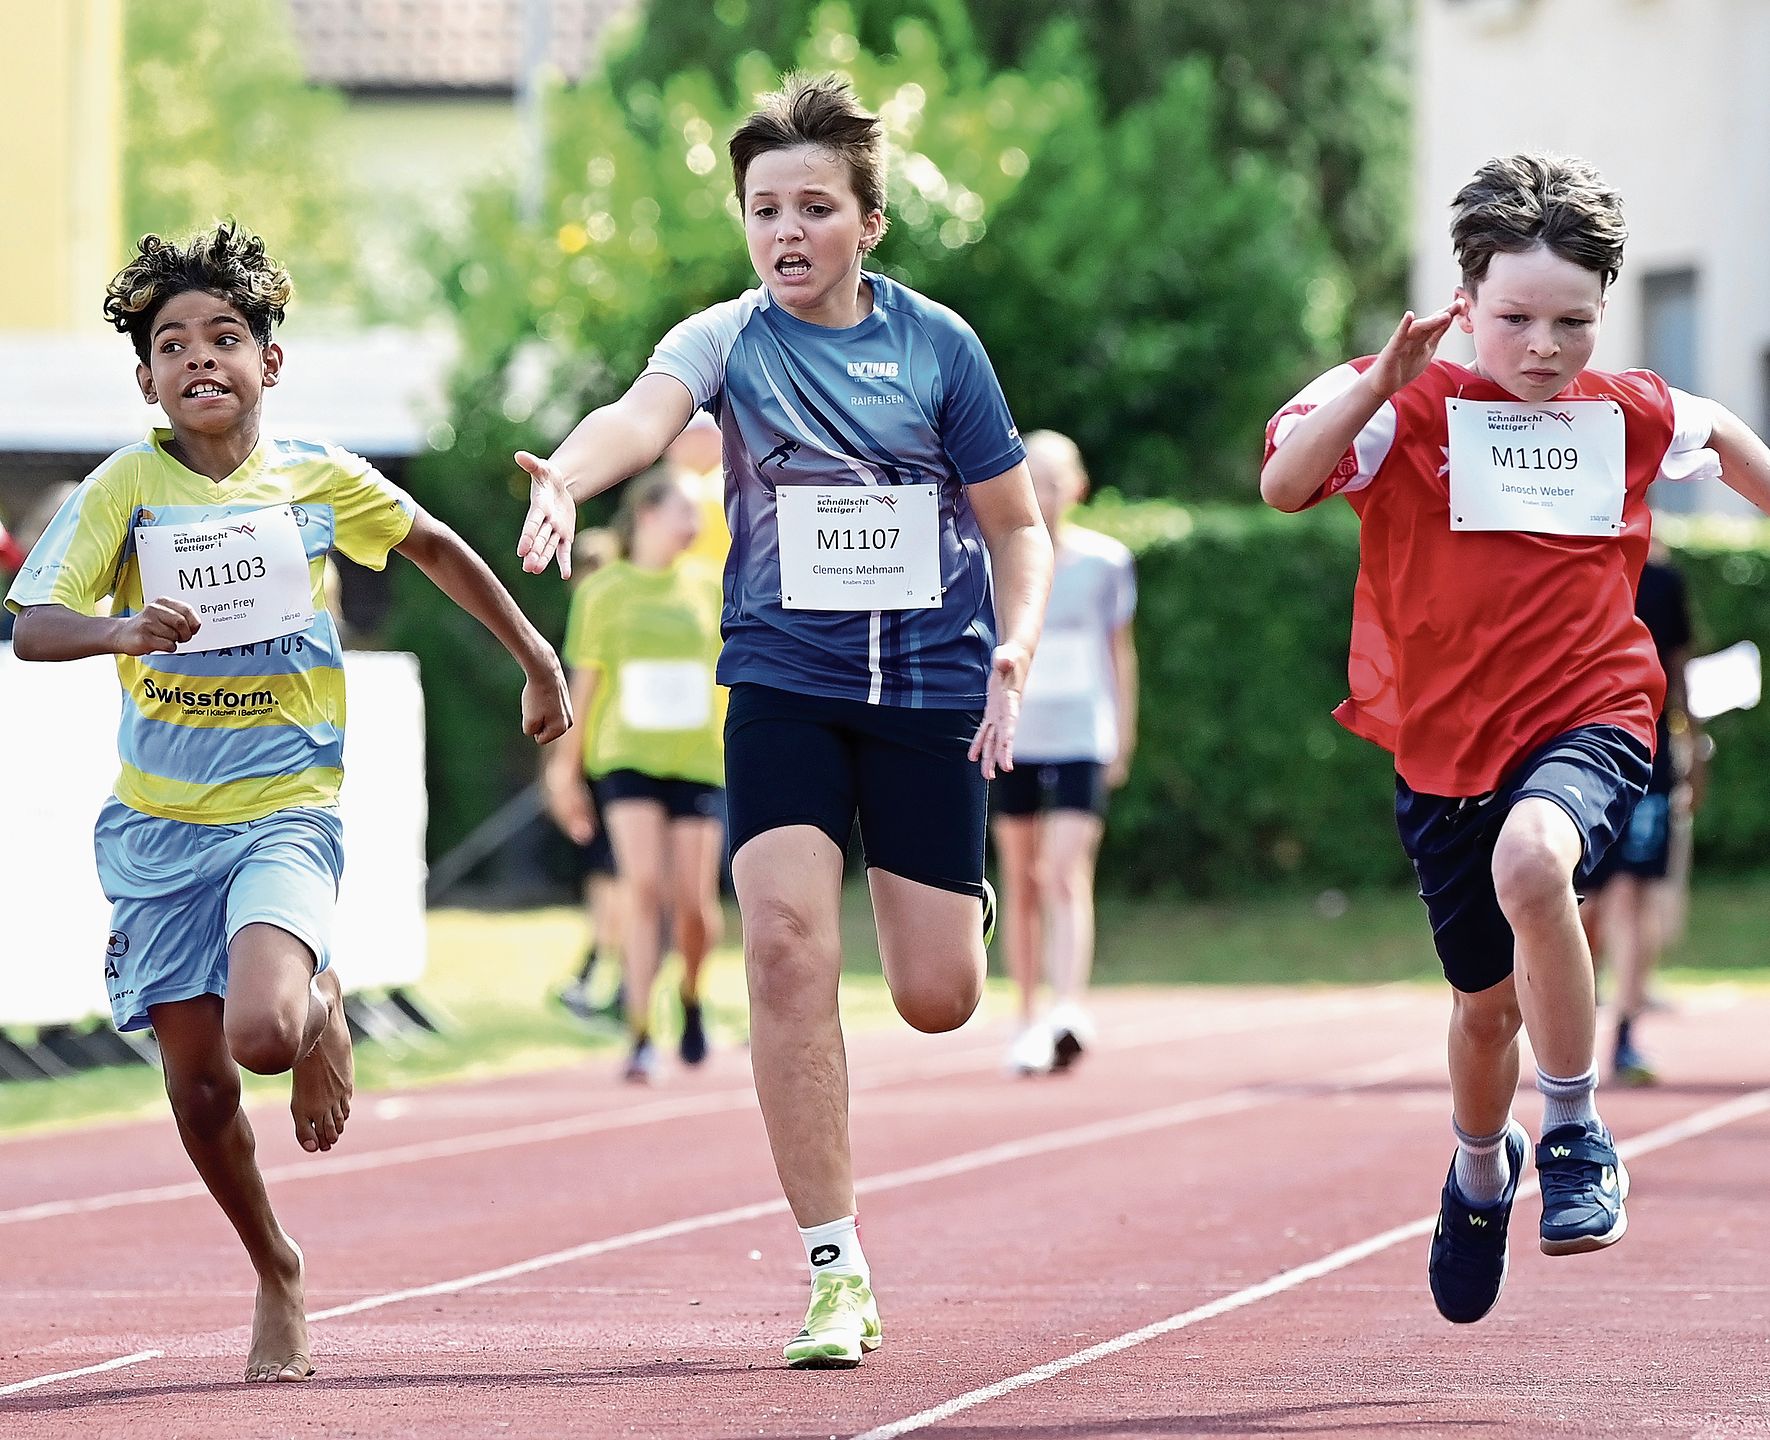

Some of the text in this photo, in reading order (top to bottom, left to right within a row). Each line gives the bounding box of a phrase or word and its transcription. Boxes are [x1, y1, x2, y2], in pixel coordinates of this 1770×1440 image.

[850, 394, 904, 406] RAIFFEISEN
[1491, 445, 1579, 471] M1109
[1501, 482, 1575, 497] Janosch Weber
[817, 528, 900, 550] M1107
[178, 555, 267, 591] M1103
[812, 564, 905, 575] Clemens Mehmann
[200, 598, 255, 614] Bryan Frey
[142, 677, 280, 708] Swissform.
[241, 707, 273, 716] Bedroom
